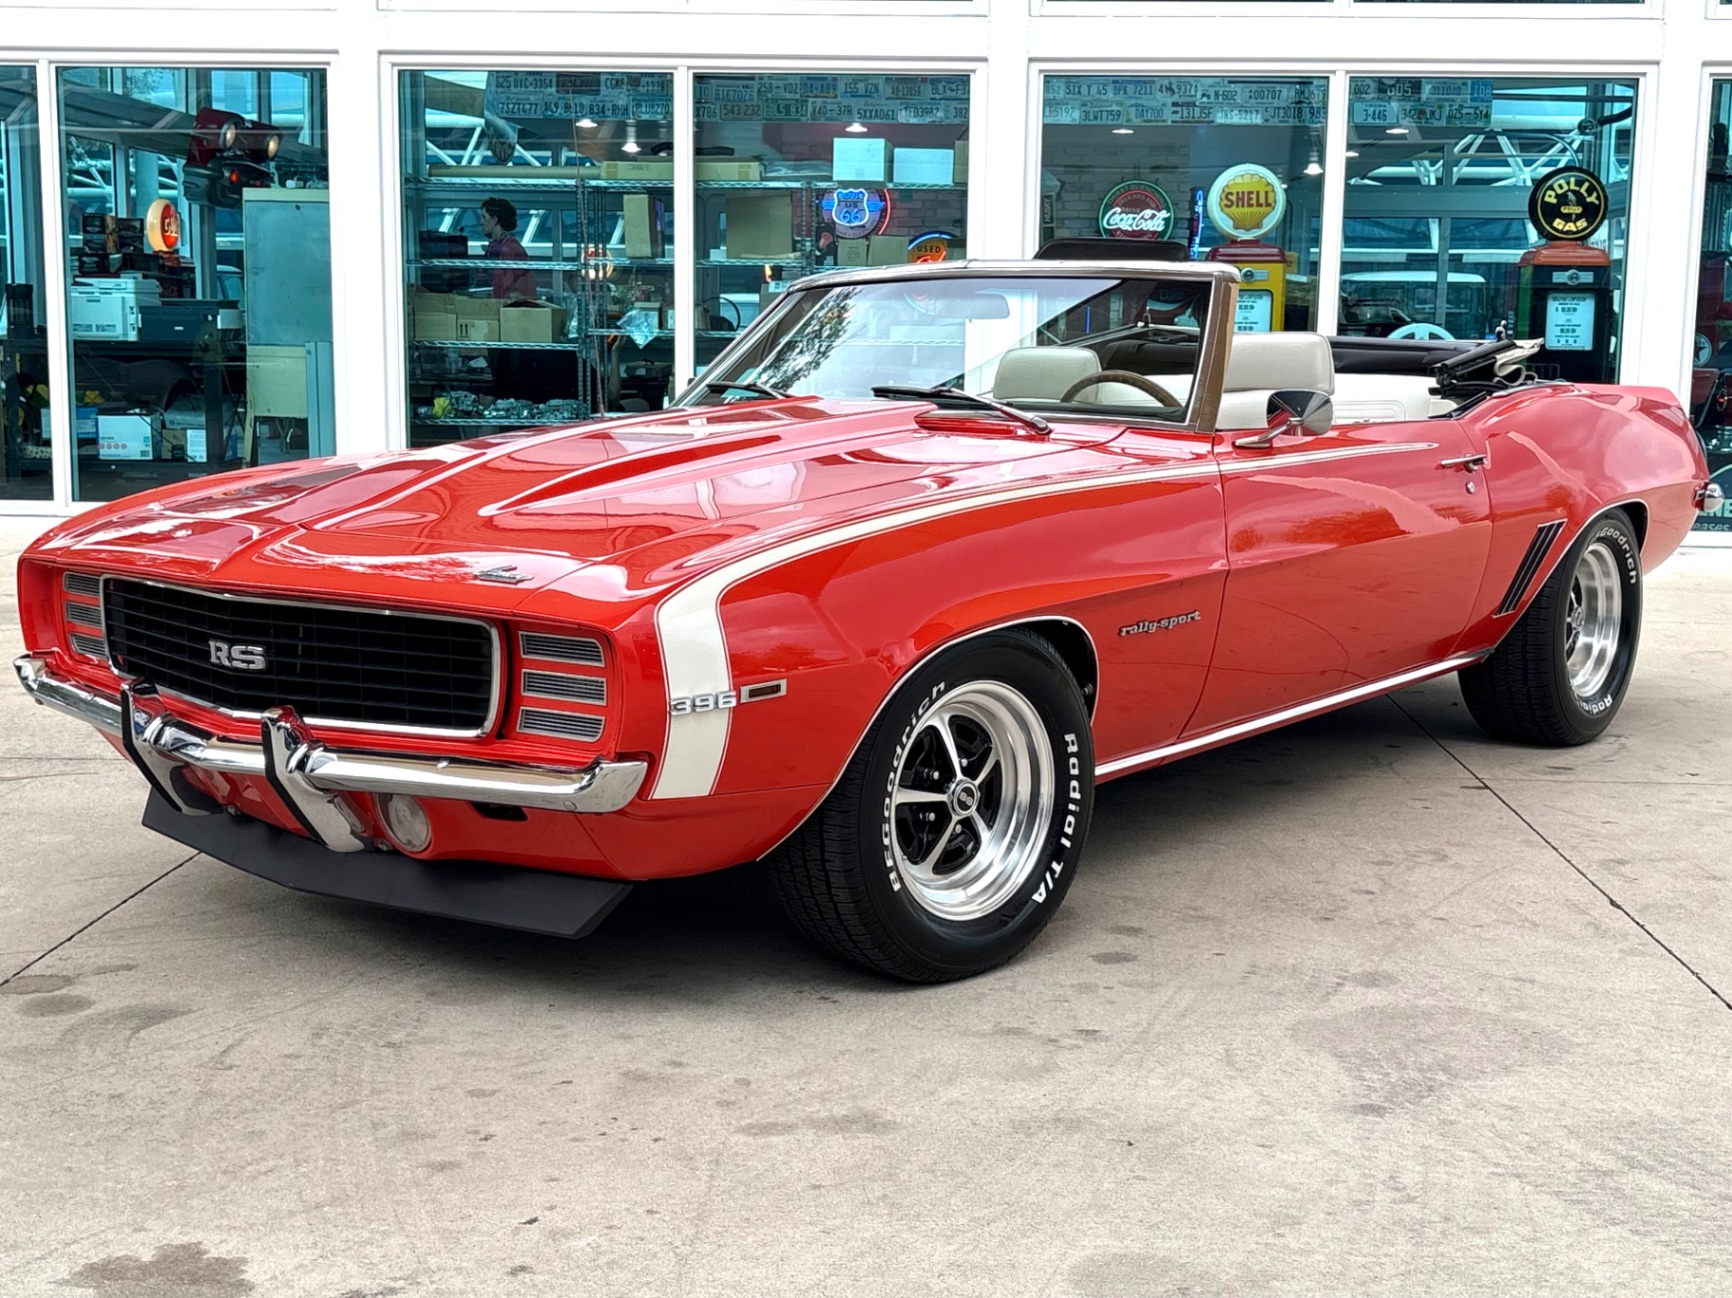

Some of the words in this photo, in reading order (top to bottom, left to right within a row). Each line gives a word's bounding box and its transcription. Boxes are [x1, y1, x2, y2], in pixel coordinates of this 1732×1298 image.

[1066, 84, 1082, 96] SIX
[1086, 84, 1092, 96] T
[1223, 190, 1272, 209] SHELL
[1544, 177, 1600, 205] POLLY
[840, 208, 860, 223] 66
[1552, 218, 1588, 232] GAS
[1120, 610, 1202, 637] rally-sport
[208, 641, 266, 670] RS
[670, 690, 737, 715] 396
